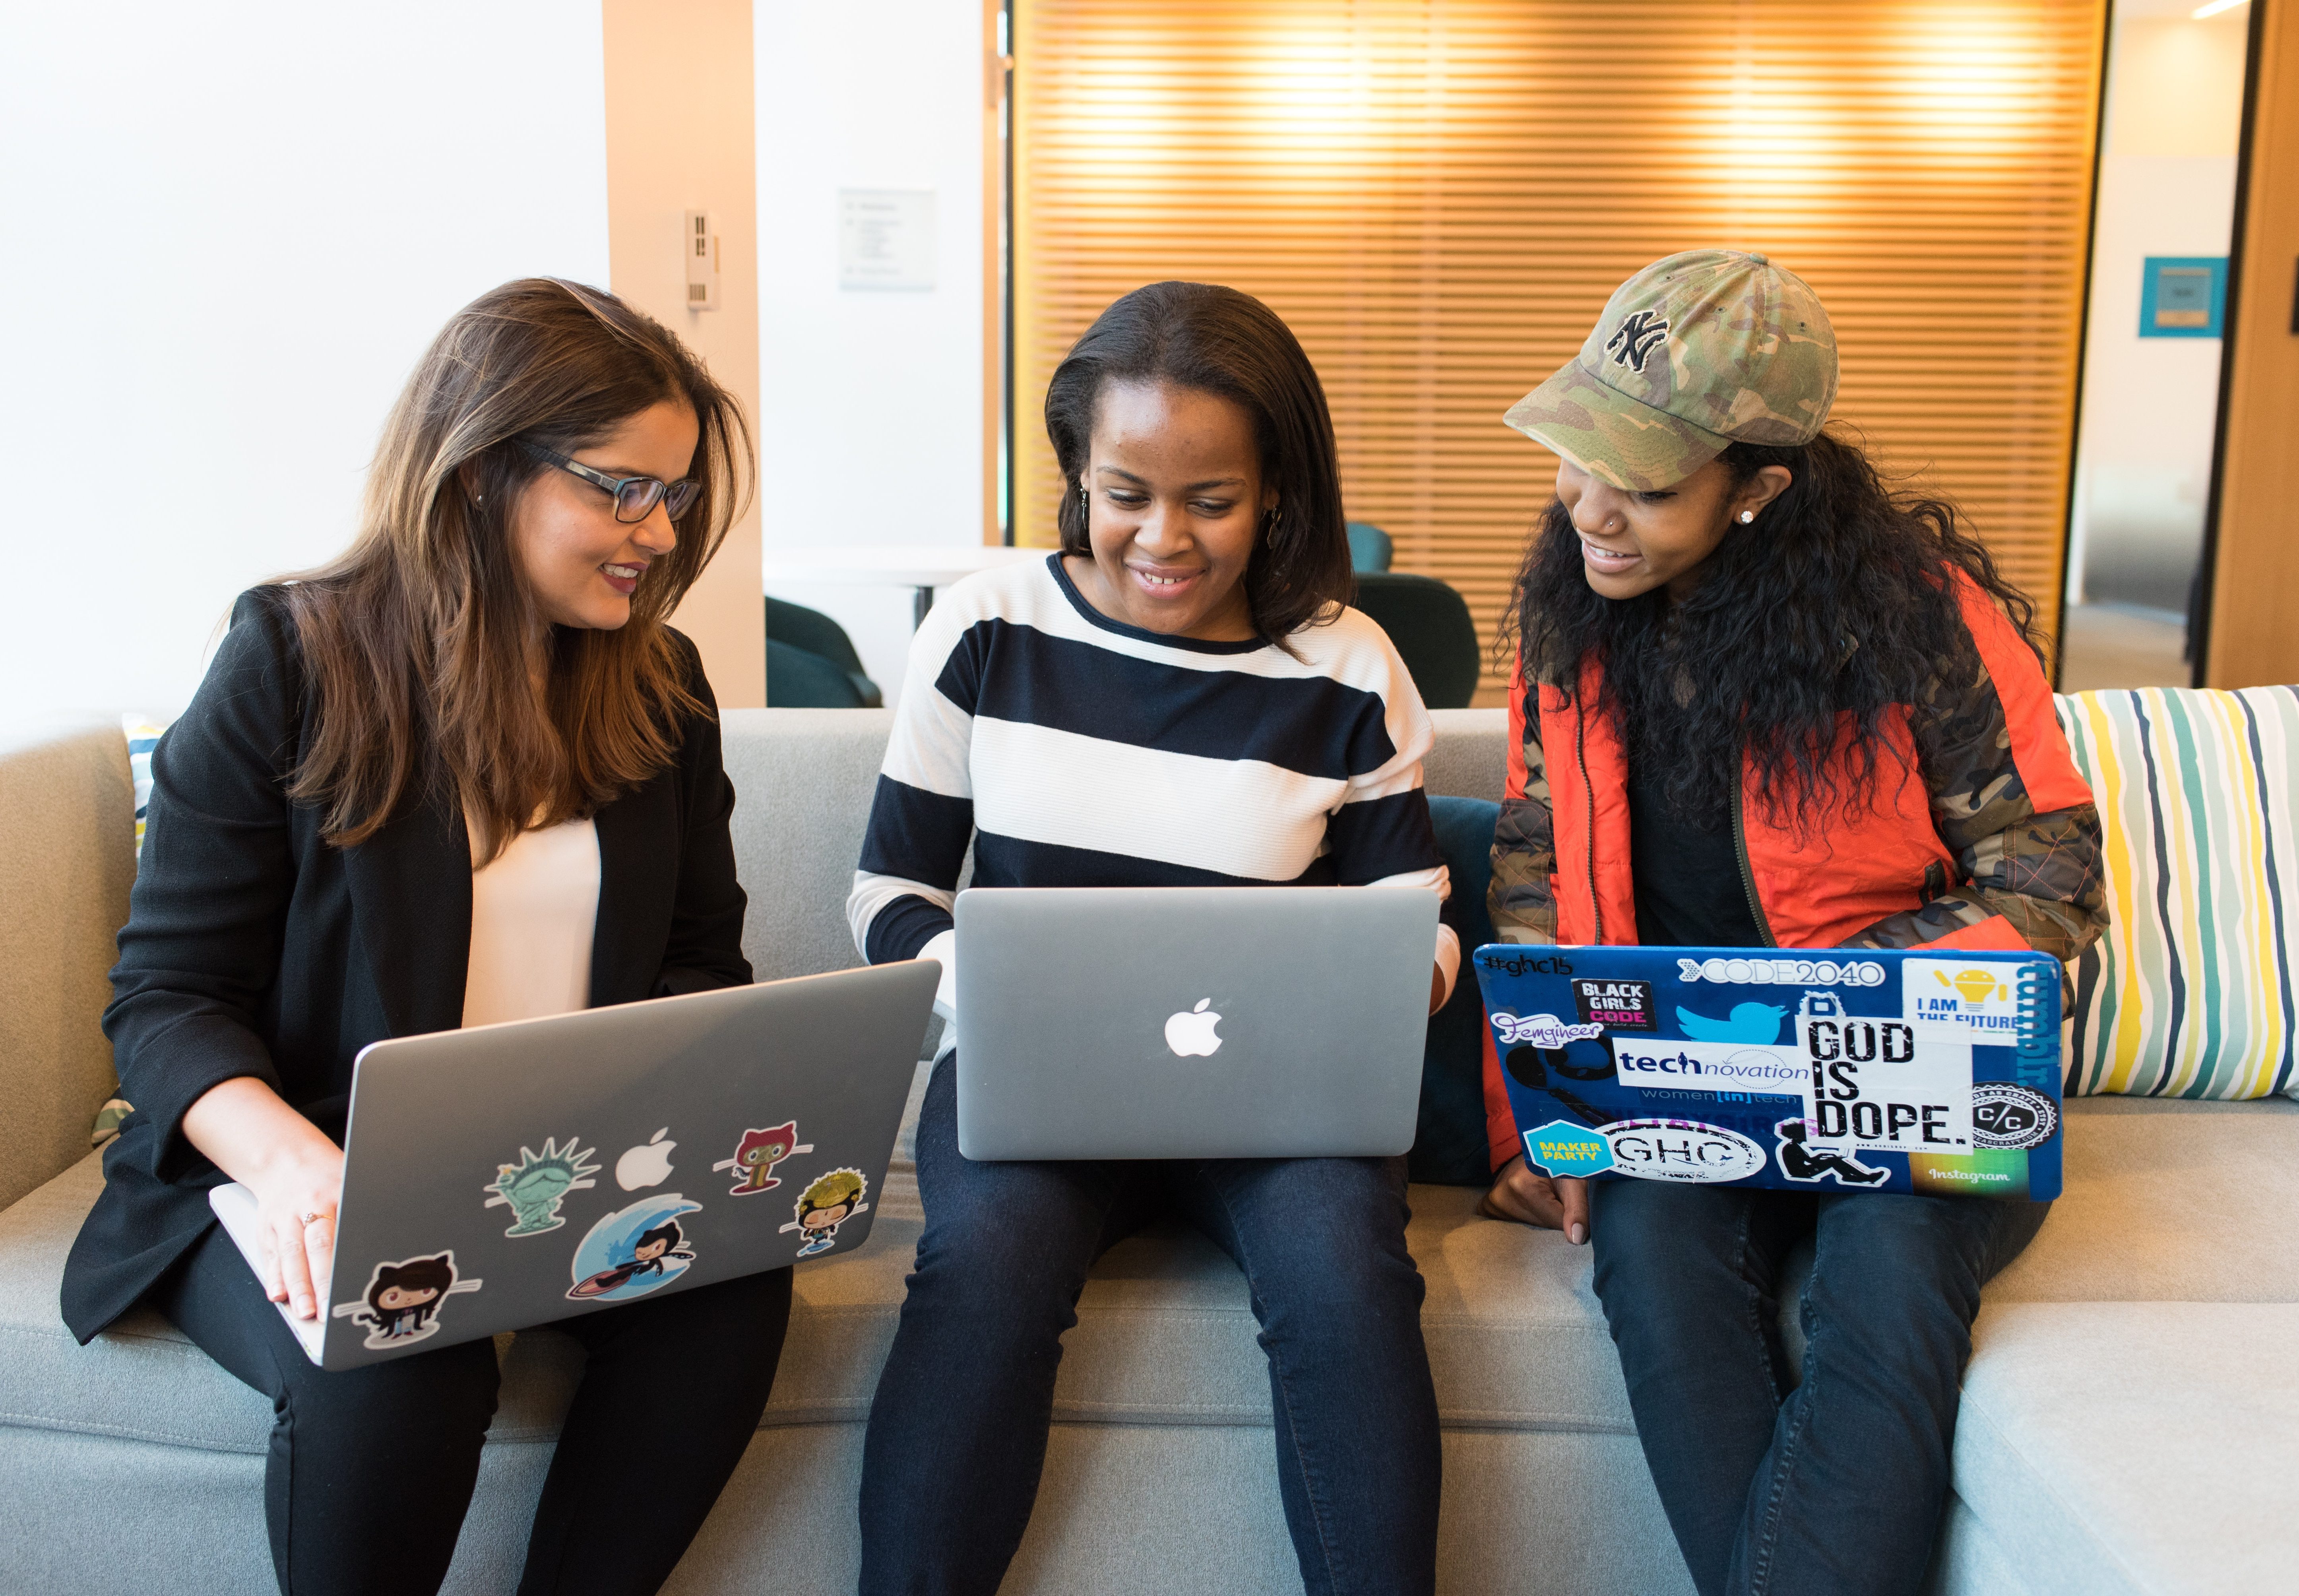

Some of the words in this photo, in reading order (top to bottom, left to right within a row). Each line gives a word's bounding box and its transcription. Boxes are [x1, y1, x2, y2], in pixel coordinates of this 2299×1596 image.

[1483, 954, 1573, 977] #ghc15
[1704, 961, 1881, 984] CODE2040
[1582, 983, 1644, 998] BLACK
[1590, 997, 1642, 1010] GIRLS
[1917, 998, 1922, 1010] I
[1929, 999, 1957, 1011] AM
[1590, 1011, 1647, 1023] CODE
[1495, 1015, 1599, 1046] Femgineer
[1808, 1021, 1914, 1063] GOD
[1812, 1061, 1860, 1100] IS
[2006, 1091, 2037, 1105] CRAFT
[1816, 1100, 1966, 1145] DOPE.
[1973, 1131, 2039, 1146] DEASCRAFT.COM
[1539, 1141, 1602, 1152] MAKER
[1614, 1137, 1731, 1167] GHC
[1542, 1151, 1597, 1161] PARTY
[1929, 1168, 2011, 1184] Instagram
